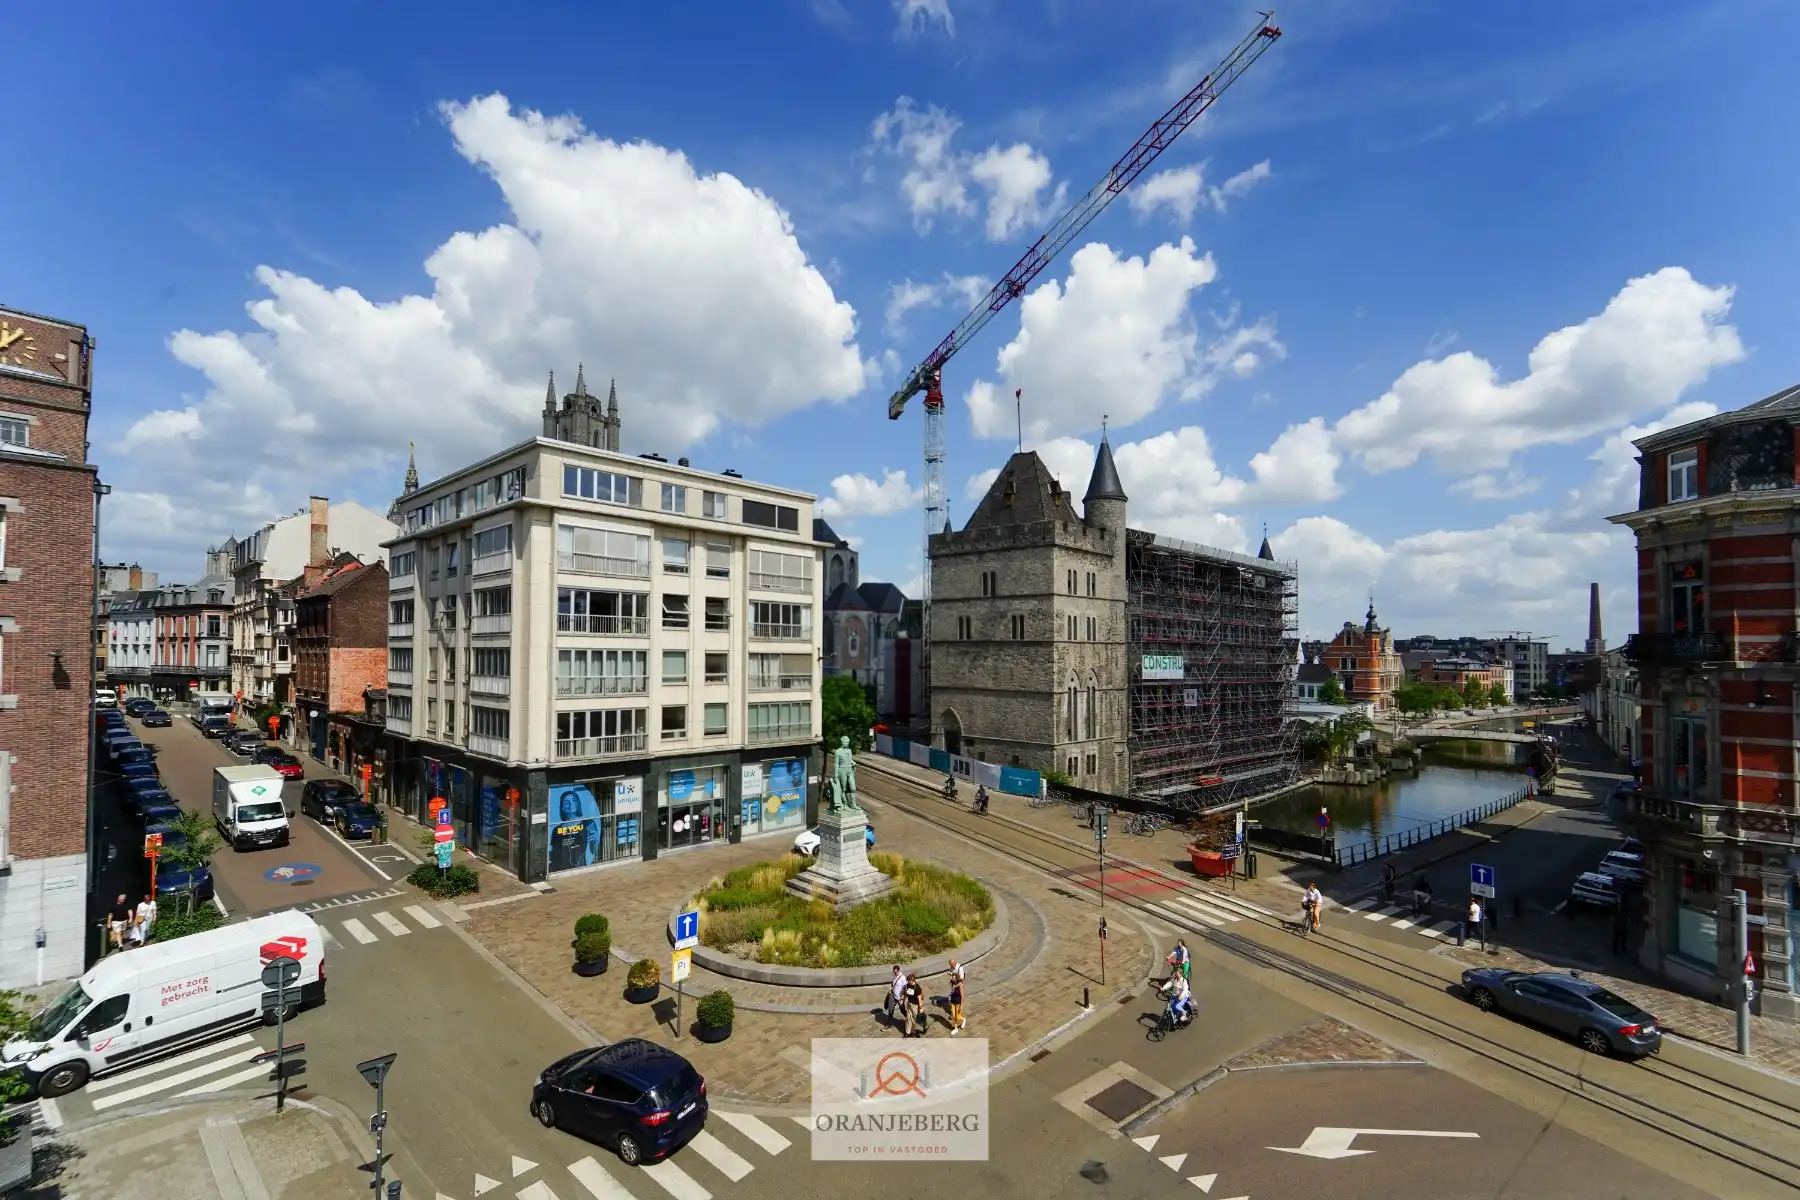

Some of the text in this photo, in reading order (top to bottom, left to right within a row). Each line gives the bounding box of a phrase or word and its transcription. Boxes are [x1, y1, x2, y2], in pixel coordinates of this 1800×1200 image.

[1143, 655, 1184, 670] CONSTRU
[617, 796, 640, 804] unique
[557, 823, 584, 834] BE YOU
[161, 976, 209, 995] Met zorg
[161, 985, 212, 1007] gebracht.
